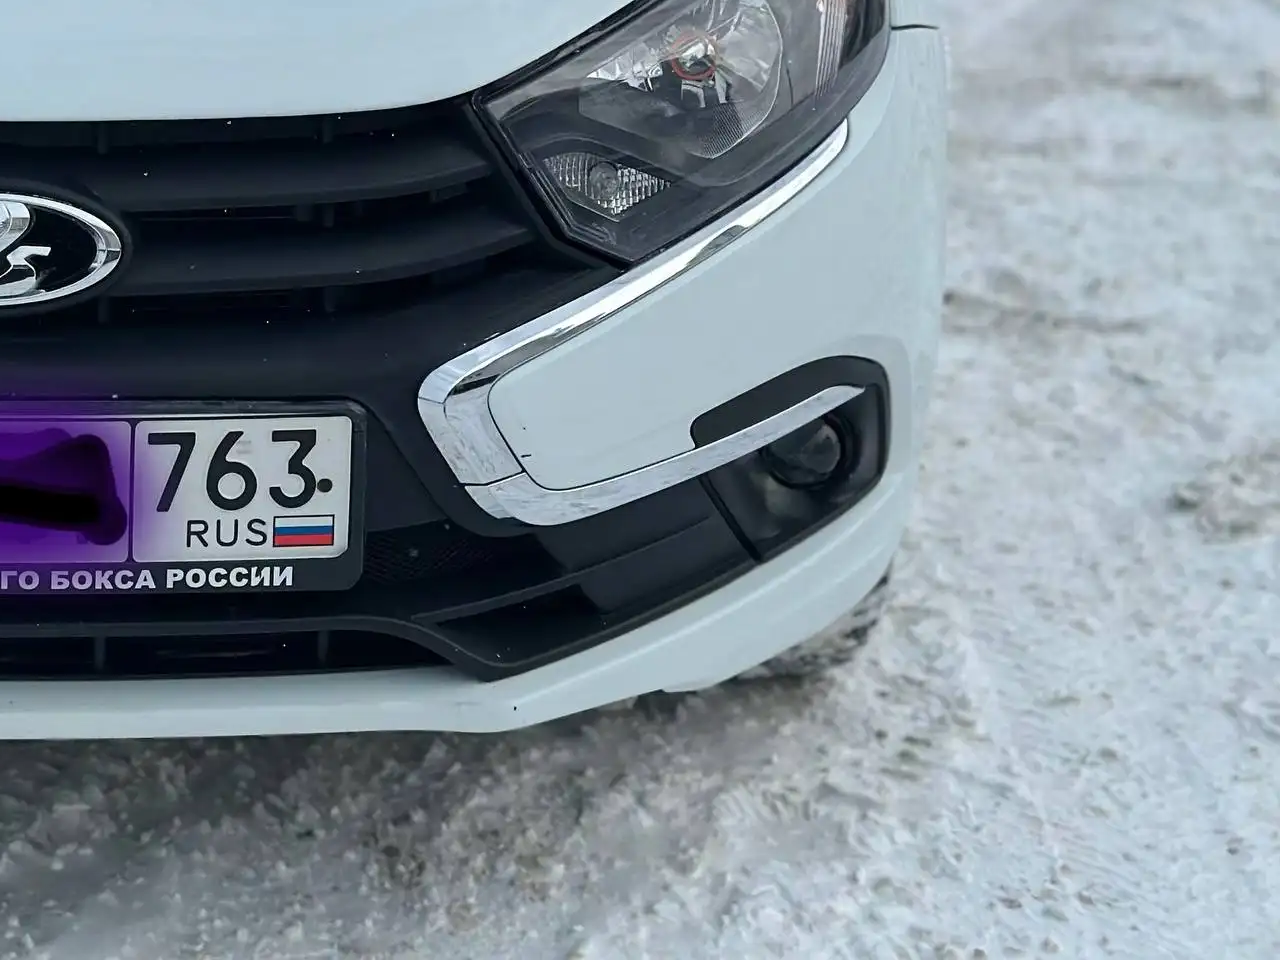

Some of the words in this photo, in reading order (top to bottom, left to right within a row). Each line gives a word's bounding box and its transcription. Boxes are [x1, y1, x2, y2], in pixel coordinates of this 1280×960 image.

[147, 429, 317, 512] 763
[186, 518, 268, 548] RUS
[49, 569, 156, 590] БОКСА
[166, 566, 293, 589] РОССИИ
